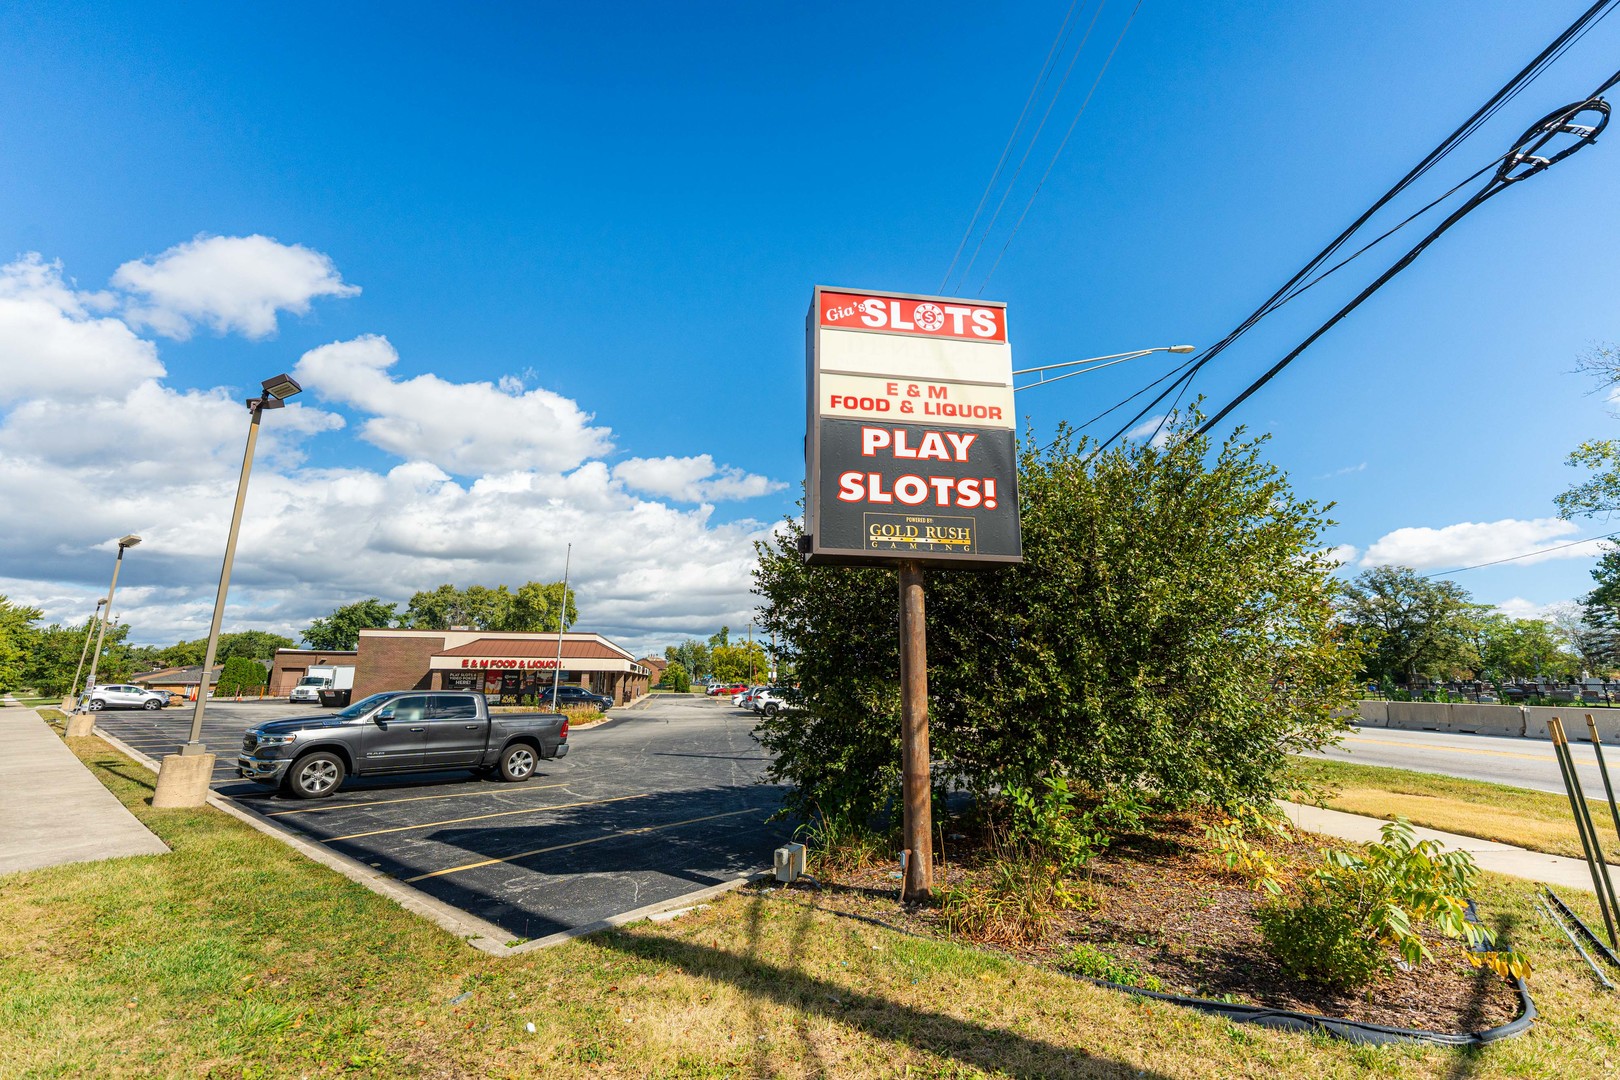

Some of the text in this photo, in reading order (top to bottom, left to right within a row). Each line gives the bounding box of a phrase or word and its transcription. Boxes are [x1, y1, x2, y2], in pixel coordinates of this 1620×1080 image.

[826, 299, 998, 337] Gia's SLOTS
[886, 382, 948, 400] E & M
[830, 395, 1002, 420] FOOD & LIQUOR
[861, 426, 979, 463] PLAY
[836, 470, 999, 511] SLOTS!
[906, 516, 926, 524] POWERED
[869, 523, 970, 540] GOLD RUSH
[461, 659, 469, 668] E
[470, 659, 478, 668] &
[480, 659, 489, 668] M
[490, 659, 517, 669] FOOD
[519, 660, 526, 669] &
